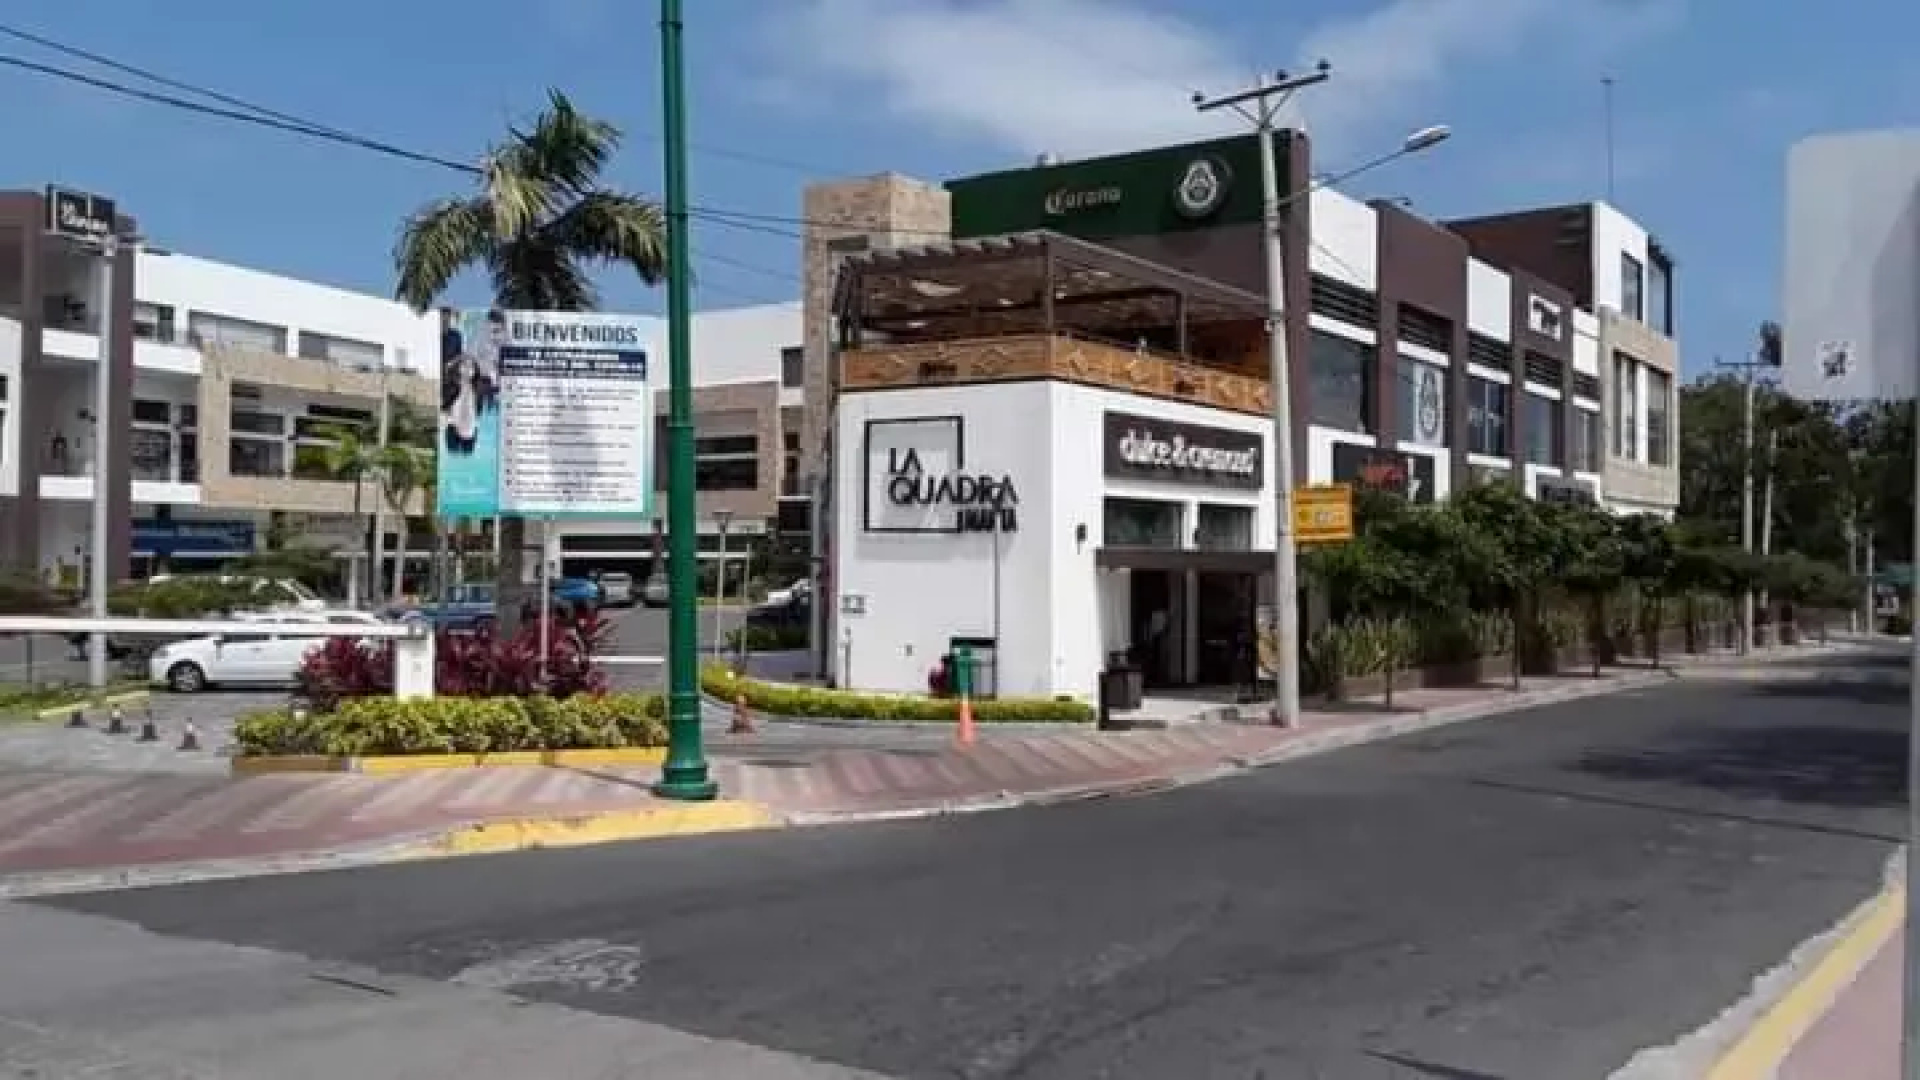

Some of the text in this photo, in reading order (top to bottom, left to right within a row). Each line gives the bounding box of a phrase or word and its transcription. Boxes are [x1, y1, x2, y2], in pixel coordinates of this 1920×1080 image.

[513, 322, 638, 343] BIENVENIDOS
[889, 447, 923, 474] LA
[888, 475, 1019, 505] QUADRA
